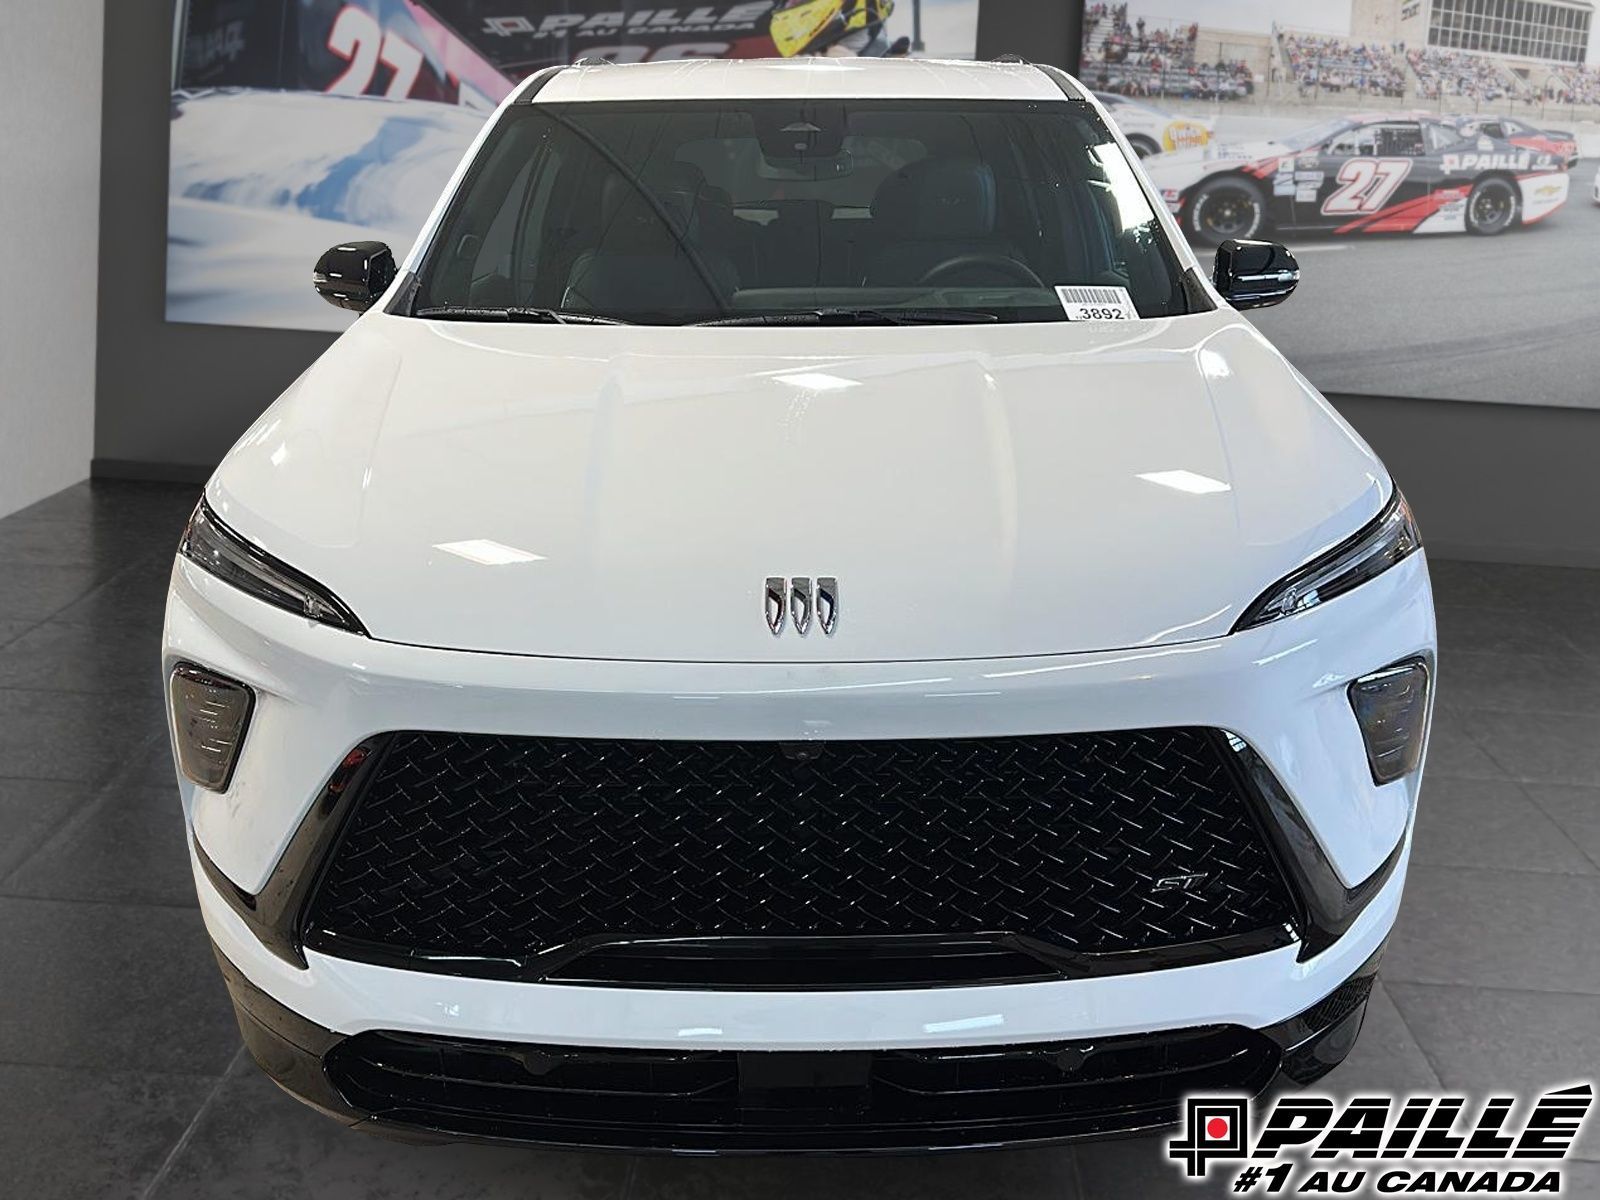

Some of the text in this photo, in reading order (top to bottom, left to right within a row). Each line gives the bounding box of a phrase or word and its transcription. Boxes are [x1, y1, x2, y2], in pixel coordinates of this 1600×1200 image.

[627, 22, 755, 34] CANADA
[323, 3, 425, 100] 27
[1321, 157, 1413, 215] 27
[1080, 308, 1125, 320] 3892
